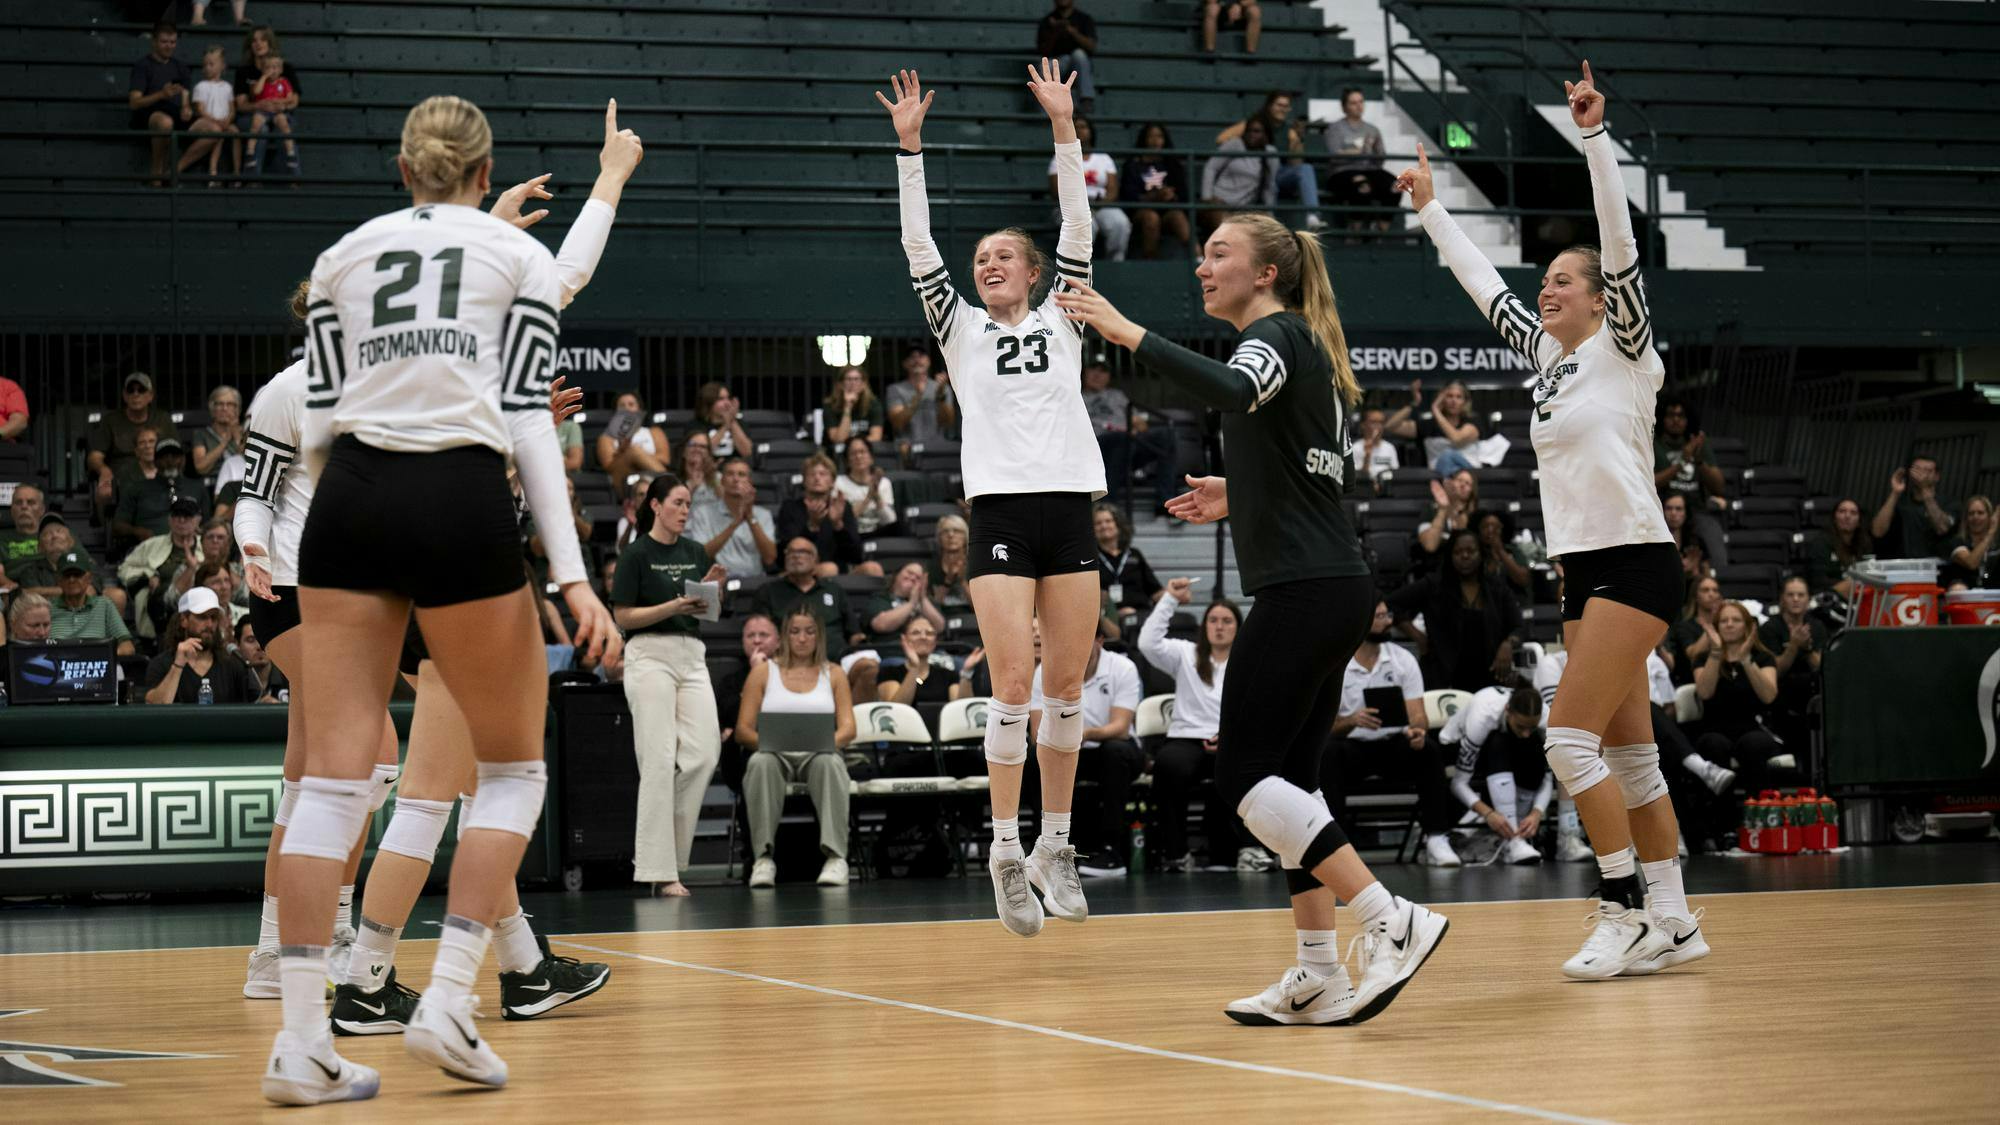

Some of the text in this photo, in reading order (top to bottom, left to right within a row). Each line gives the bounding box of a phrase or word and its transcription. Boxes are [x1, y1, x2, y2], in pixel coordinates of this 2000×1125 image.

[373, 247, 464, 328] 21
[359, 328, 478, 369] FORMANKOVA
[556, 347, 631, 371] ATING
[997, 335, 1049, 375] 23
[1350, 347, 1438, 371] SERVED
[1897, 598, 1920, 626] G
[61, 660, 108, 671] INSTANT
[64, 669, 107, 680] REPLAY
